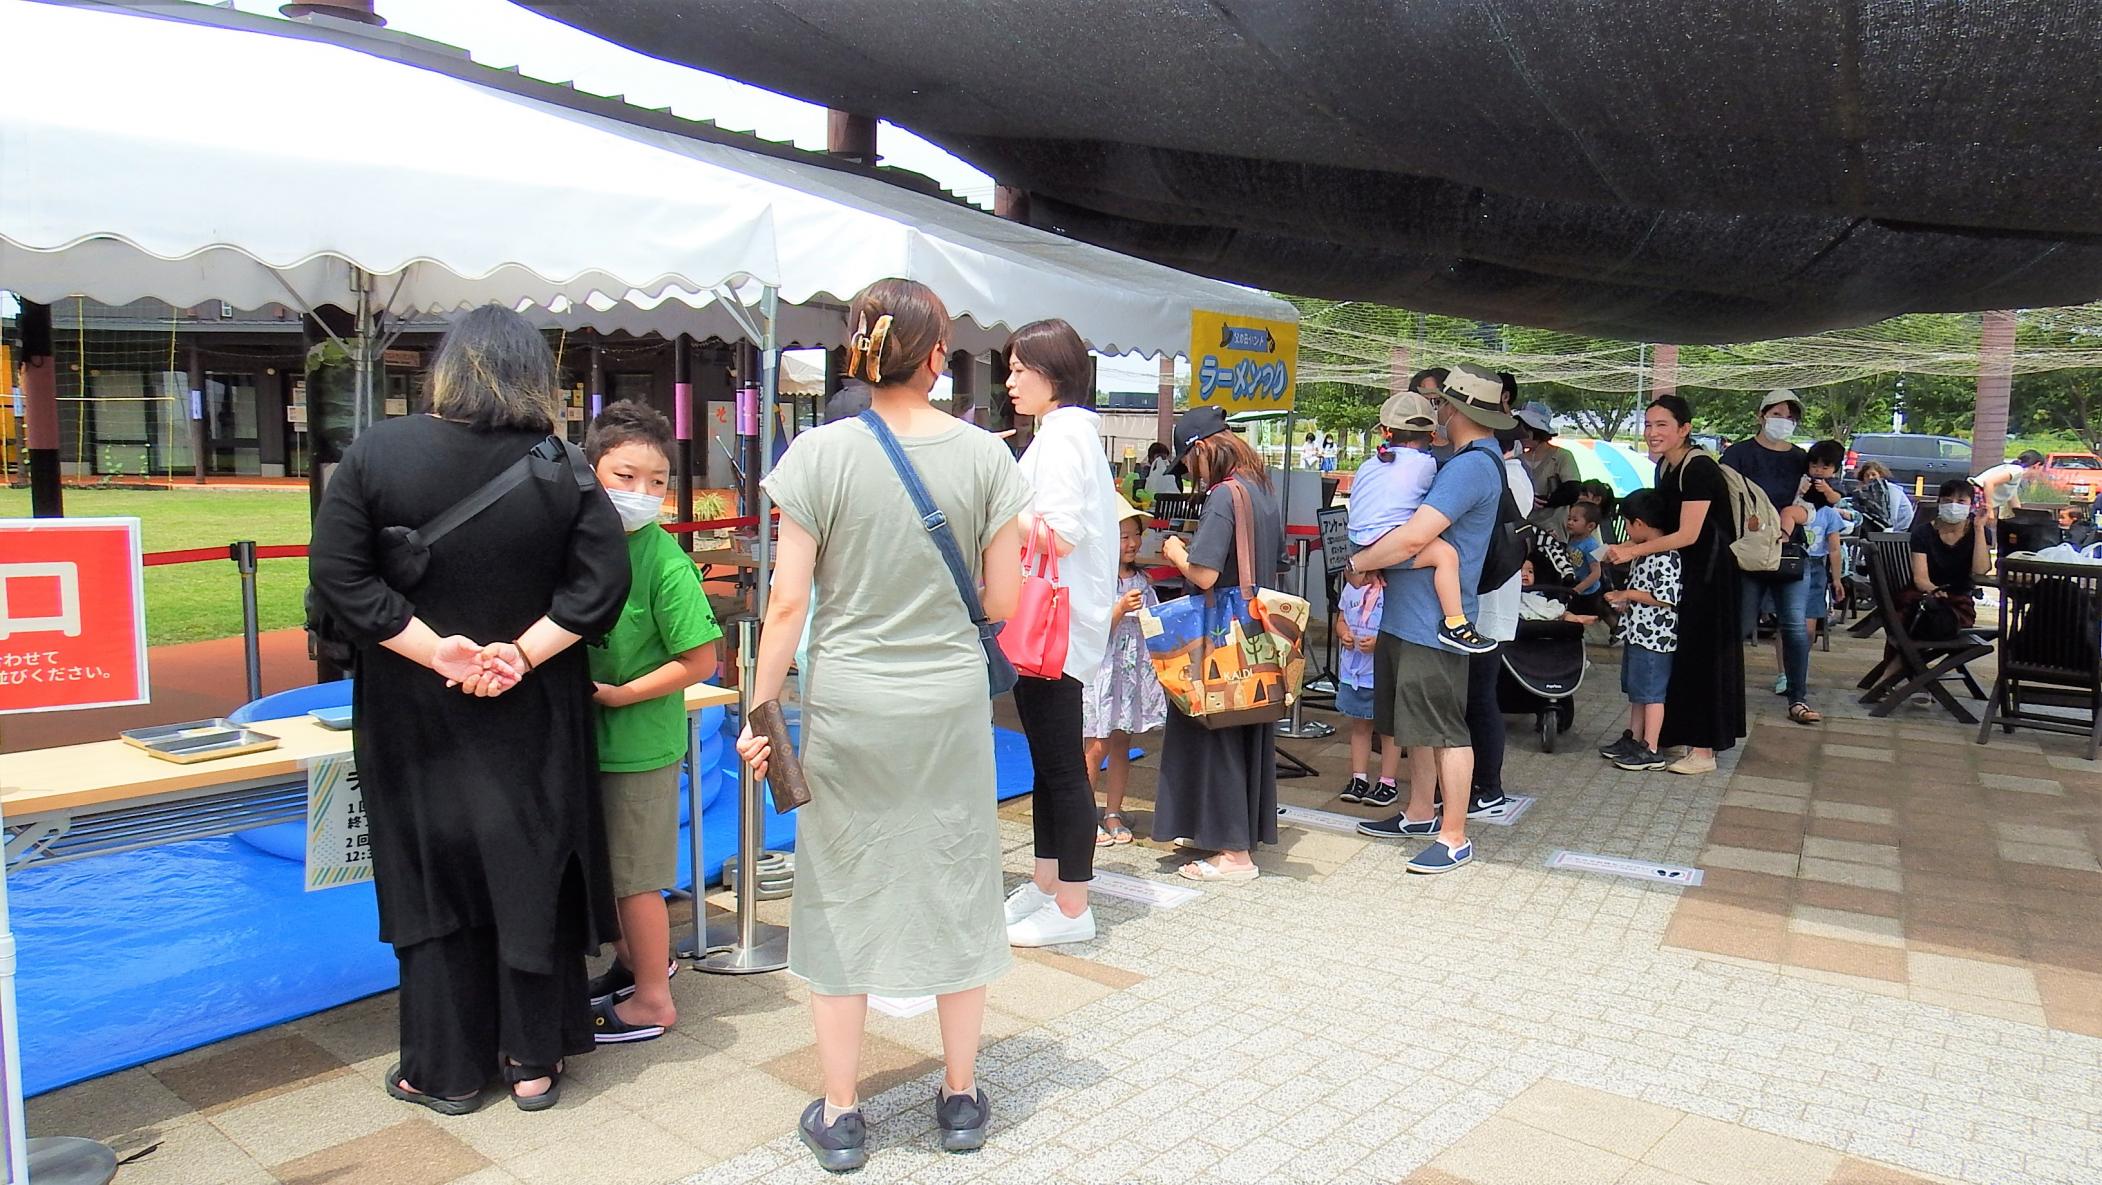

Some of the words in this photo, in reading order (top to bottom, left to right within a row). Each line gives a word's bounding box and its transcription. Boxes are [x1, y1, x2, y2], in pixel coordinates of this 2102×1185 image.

[0, 651, 59, 667] わせて
[1223, 667, 1253, 681] KALDI
